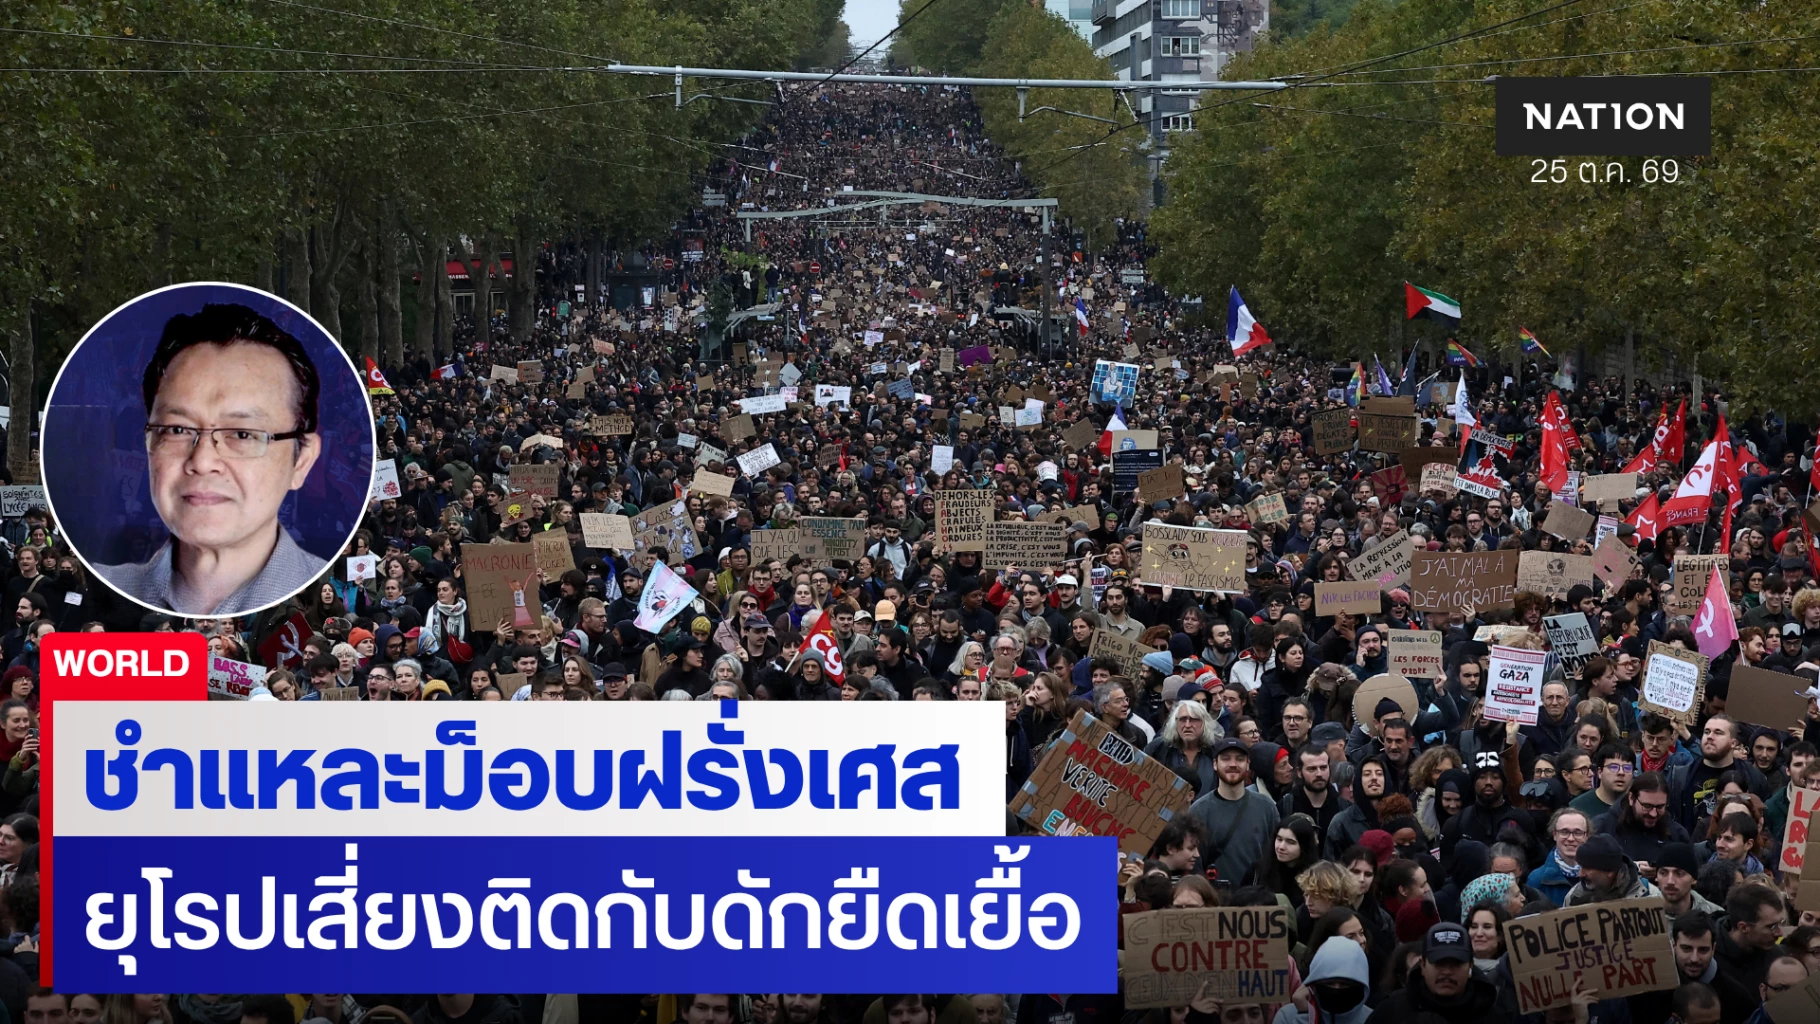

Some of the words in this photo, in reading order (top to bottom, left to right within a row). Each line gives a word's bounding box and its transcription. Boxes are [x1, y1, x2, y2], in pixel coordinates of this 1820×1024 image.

[593, 417, 611, 425] THIS
[1472, 431, 1480, 439] LA
[1464, 482, 1477, 491] DANS
[941, 499, 992, 509] FRAUDEURS
[941, 508, 981, 517] ABJECTS
[941, 516, 987, 526] CRAPULES
[941, 533, 983, 543] ORDURES
[463, 553, 534, 572] MACRONIE
[1419, 556, 1457, 577] J'AI
[1460, 556, 1490, 578] MAL
[1455, 577, 1475, 588] MA
[1683, 574, 1696, 585] ET
[1413, 584, 1516, 608] DÉMOCRATIE
[1544, 618, 1561, 630] LA
[1096, 631, 1123, 651] FRIGO
[1555, 642, 1579, 656] C'EST
[1393, 655, 1408, 663] LES
[1499, 668, 1530, 684] GAZA
[209, 678, 222, 689] SE
[1128, 911, 1215, 946] C'EST
[1218, 909, 1287, 940] NOUS
[1597, 907, 1666, 943] PARTOUT
[1151, 939, 1269, 973] CONTRE
[1555, 939, 1636, 971] JUSTICE
[1602, 957, 1657, 990] PART
[1238, 969, 1288, 998] HAUT
